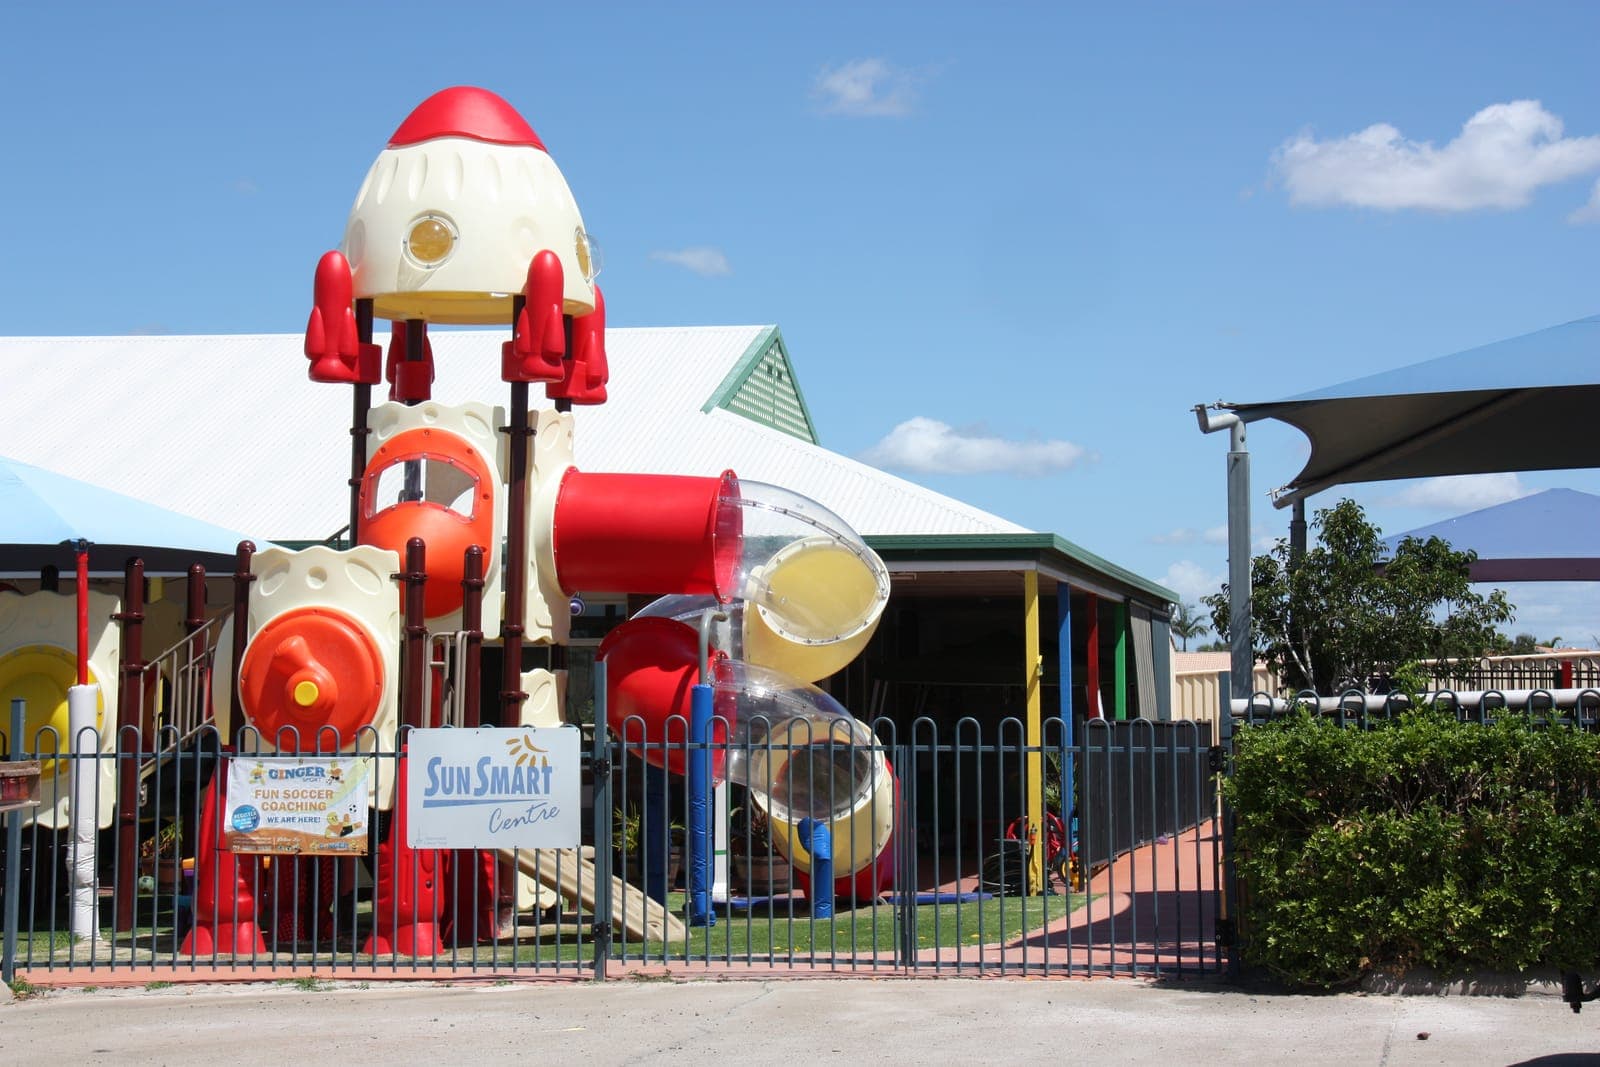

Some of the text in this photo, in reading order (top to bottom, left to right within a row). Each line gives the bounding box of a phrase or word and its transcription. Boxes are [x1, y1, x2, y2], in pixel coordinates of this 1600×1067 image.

[268, 767, 325, 779] GINGER
[254, 789, 334, 800] FUN SOCCER
[261, 801, 327, 812] COACHING
[488, 802, 561, 834] Centre
